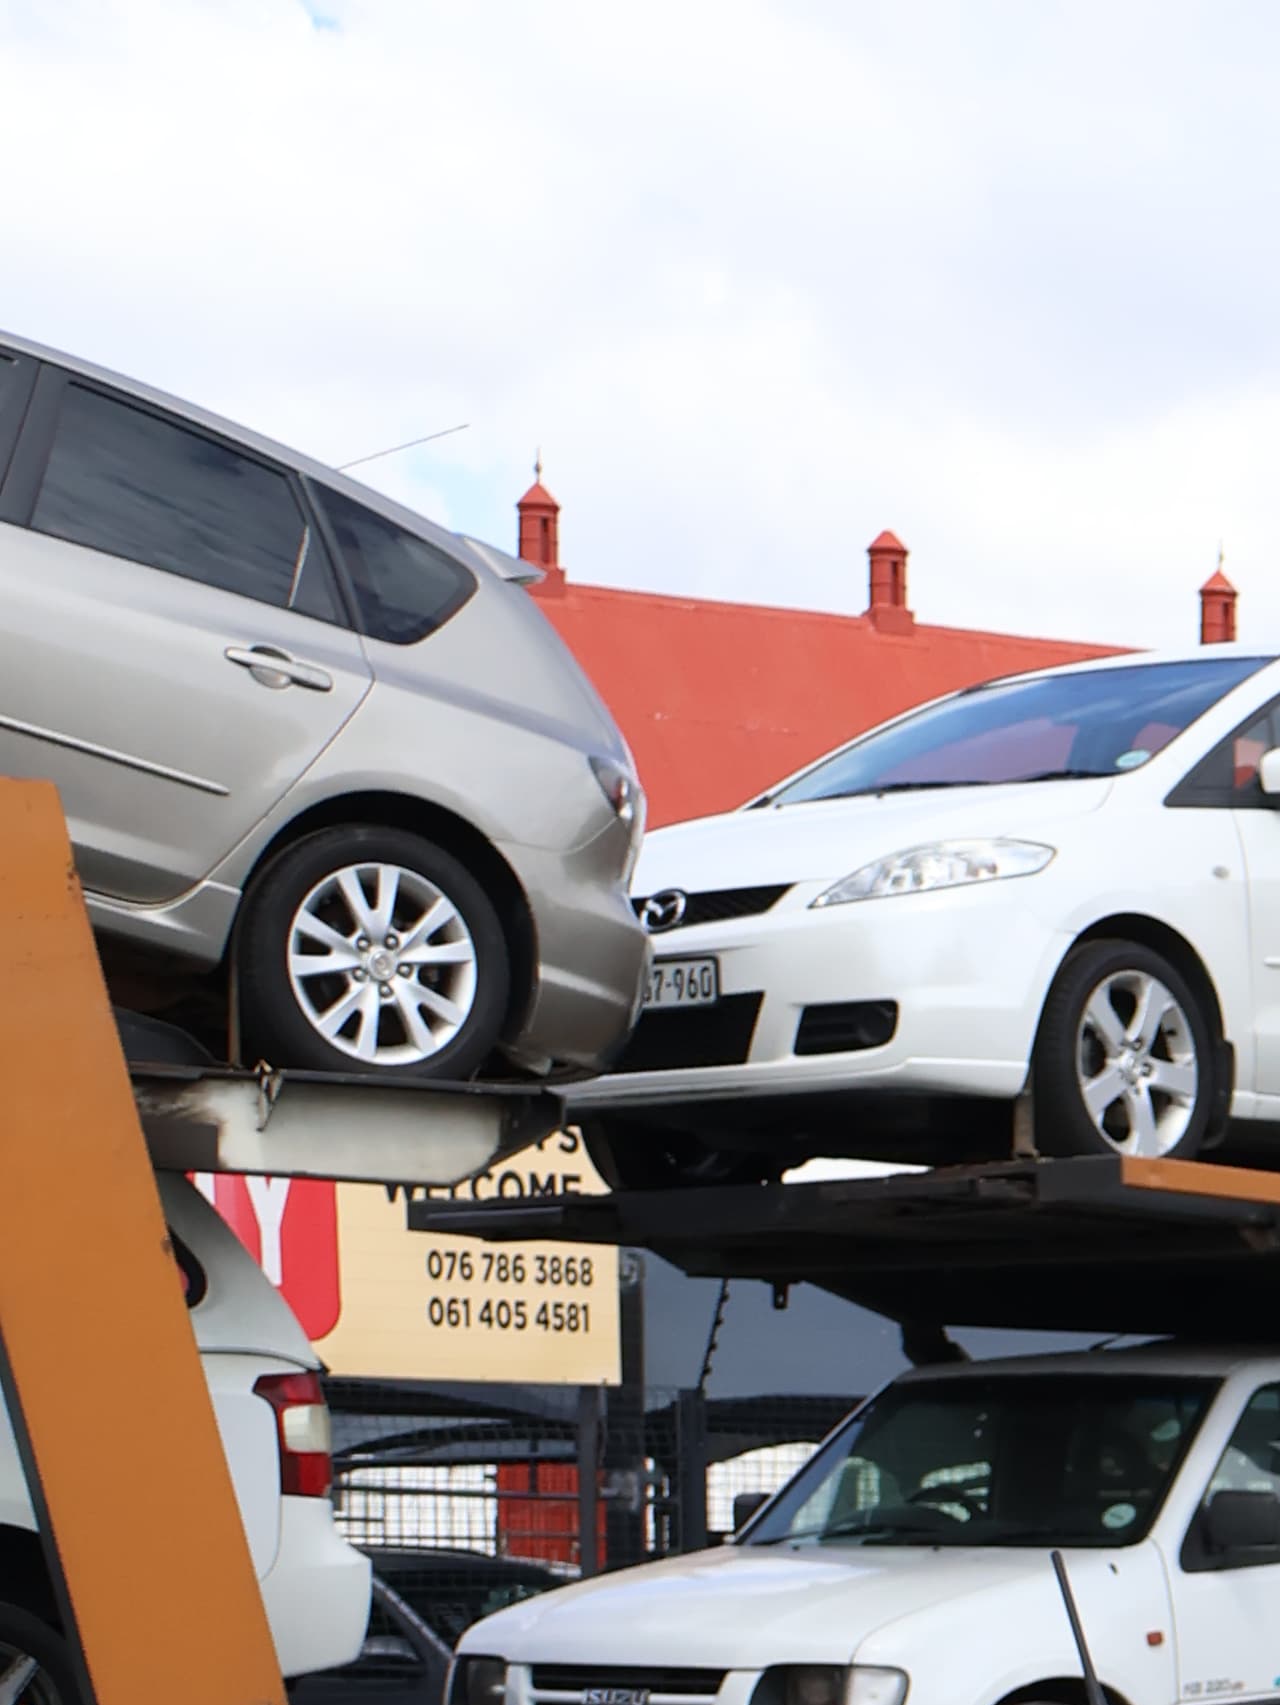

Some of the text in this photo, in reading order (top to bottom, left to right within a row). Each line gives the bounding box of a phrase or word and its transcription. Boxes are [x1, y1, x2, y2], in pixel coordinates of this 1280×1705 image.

[427, 1249, 593, 1288] 076 786 3868
[428, 1296, 590, 1334] 061 405 4581
